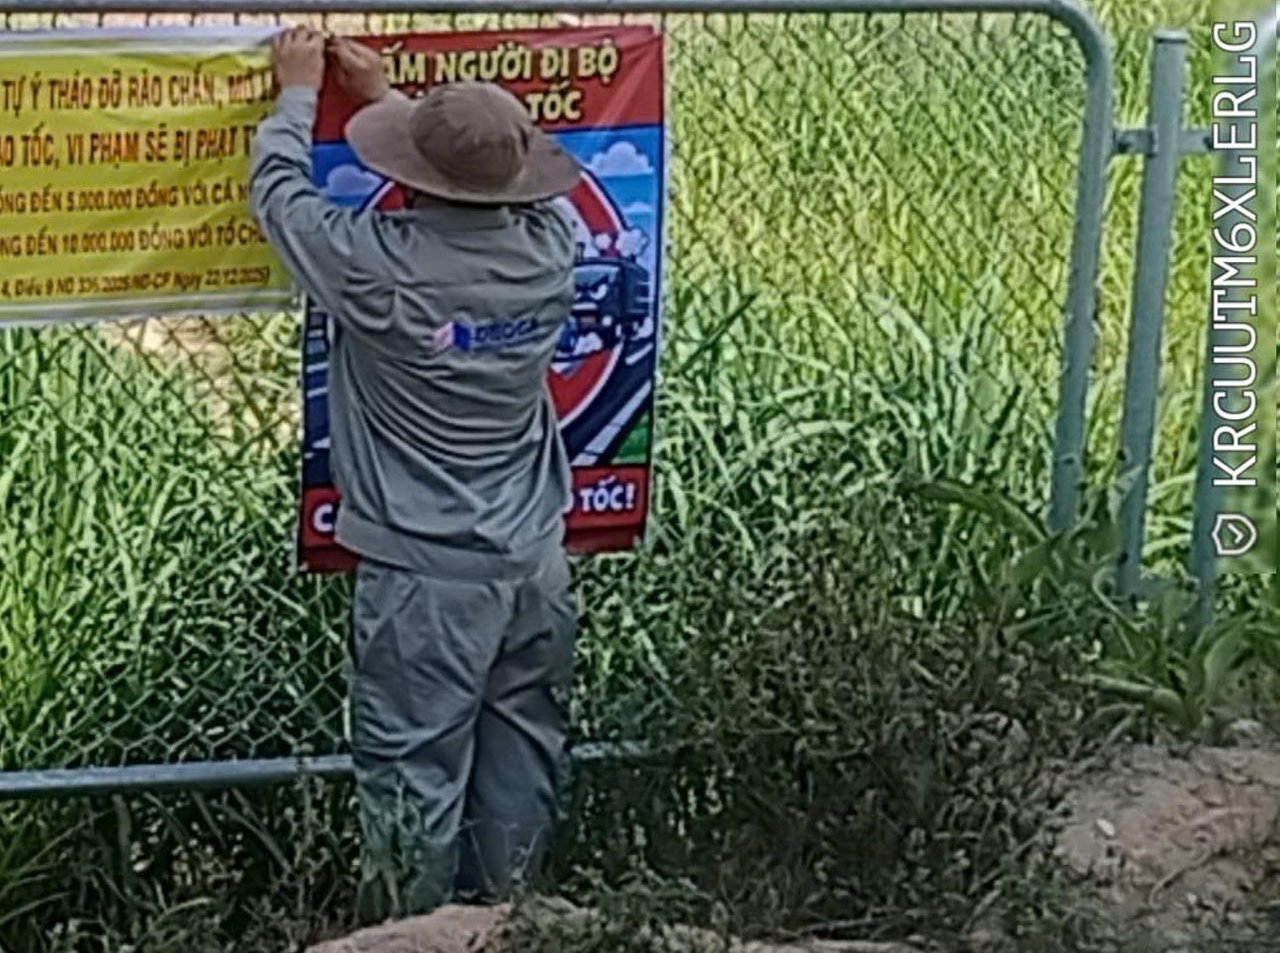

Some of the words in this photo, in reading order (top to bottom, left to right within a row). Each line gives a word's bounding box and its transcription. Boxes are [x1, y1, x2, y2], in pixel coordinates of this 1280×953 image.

[380, 40, 426, 84] ẤM
[434, 41, 532, 82] NGƯỜI
[539, 46, 570, 80] ĐI
[577, 37, 619, 84] BỘ
[2, 75, 27, 118] TỰ
[31, 71, 43, 111] Ý
[47, 69, 92, 111] THÁO
[128, 68, 162, 108] RÀO
[525, 81, 583, 121] TỐC
[21, 121, 60, 170] TỐC,
[66, 134, 84, 166] VI
[89, 131, 140, 169] PHẠM
[145, 123, 169, 162] SẼ
[173, 129, 191, 167] BỊ
[195, 125, 239, 165] PHẠT
[30, 184, 63, 213] ĐẾN
[136, 180, 179, 209] ĐỒNG
[211, 177, 234, 205] CÁ
[26, 226, 58, 256] ĐẾN
[139, 221, 185, 251] ĐỒNG
[580, 475, 636, 513] TỐC!
